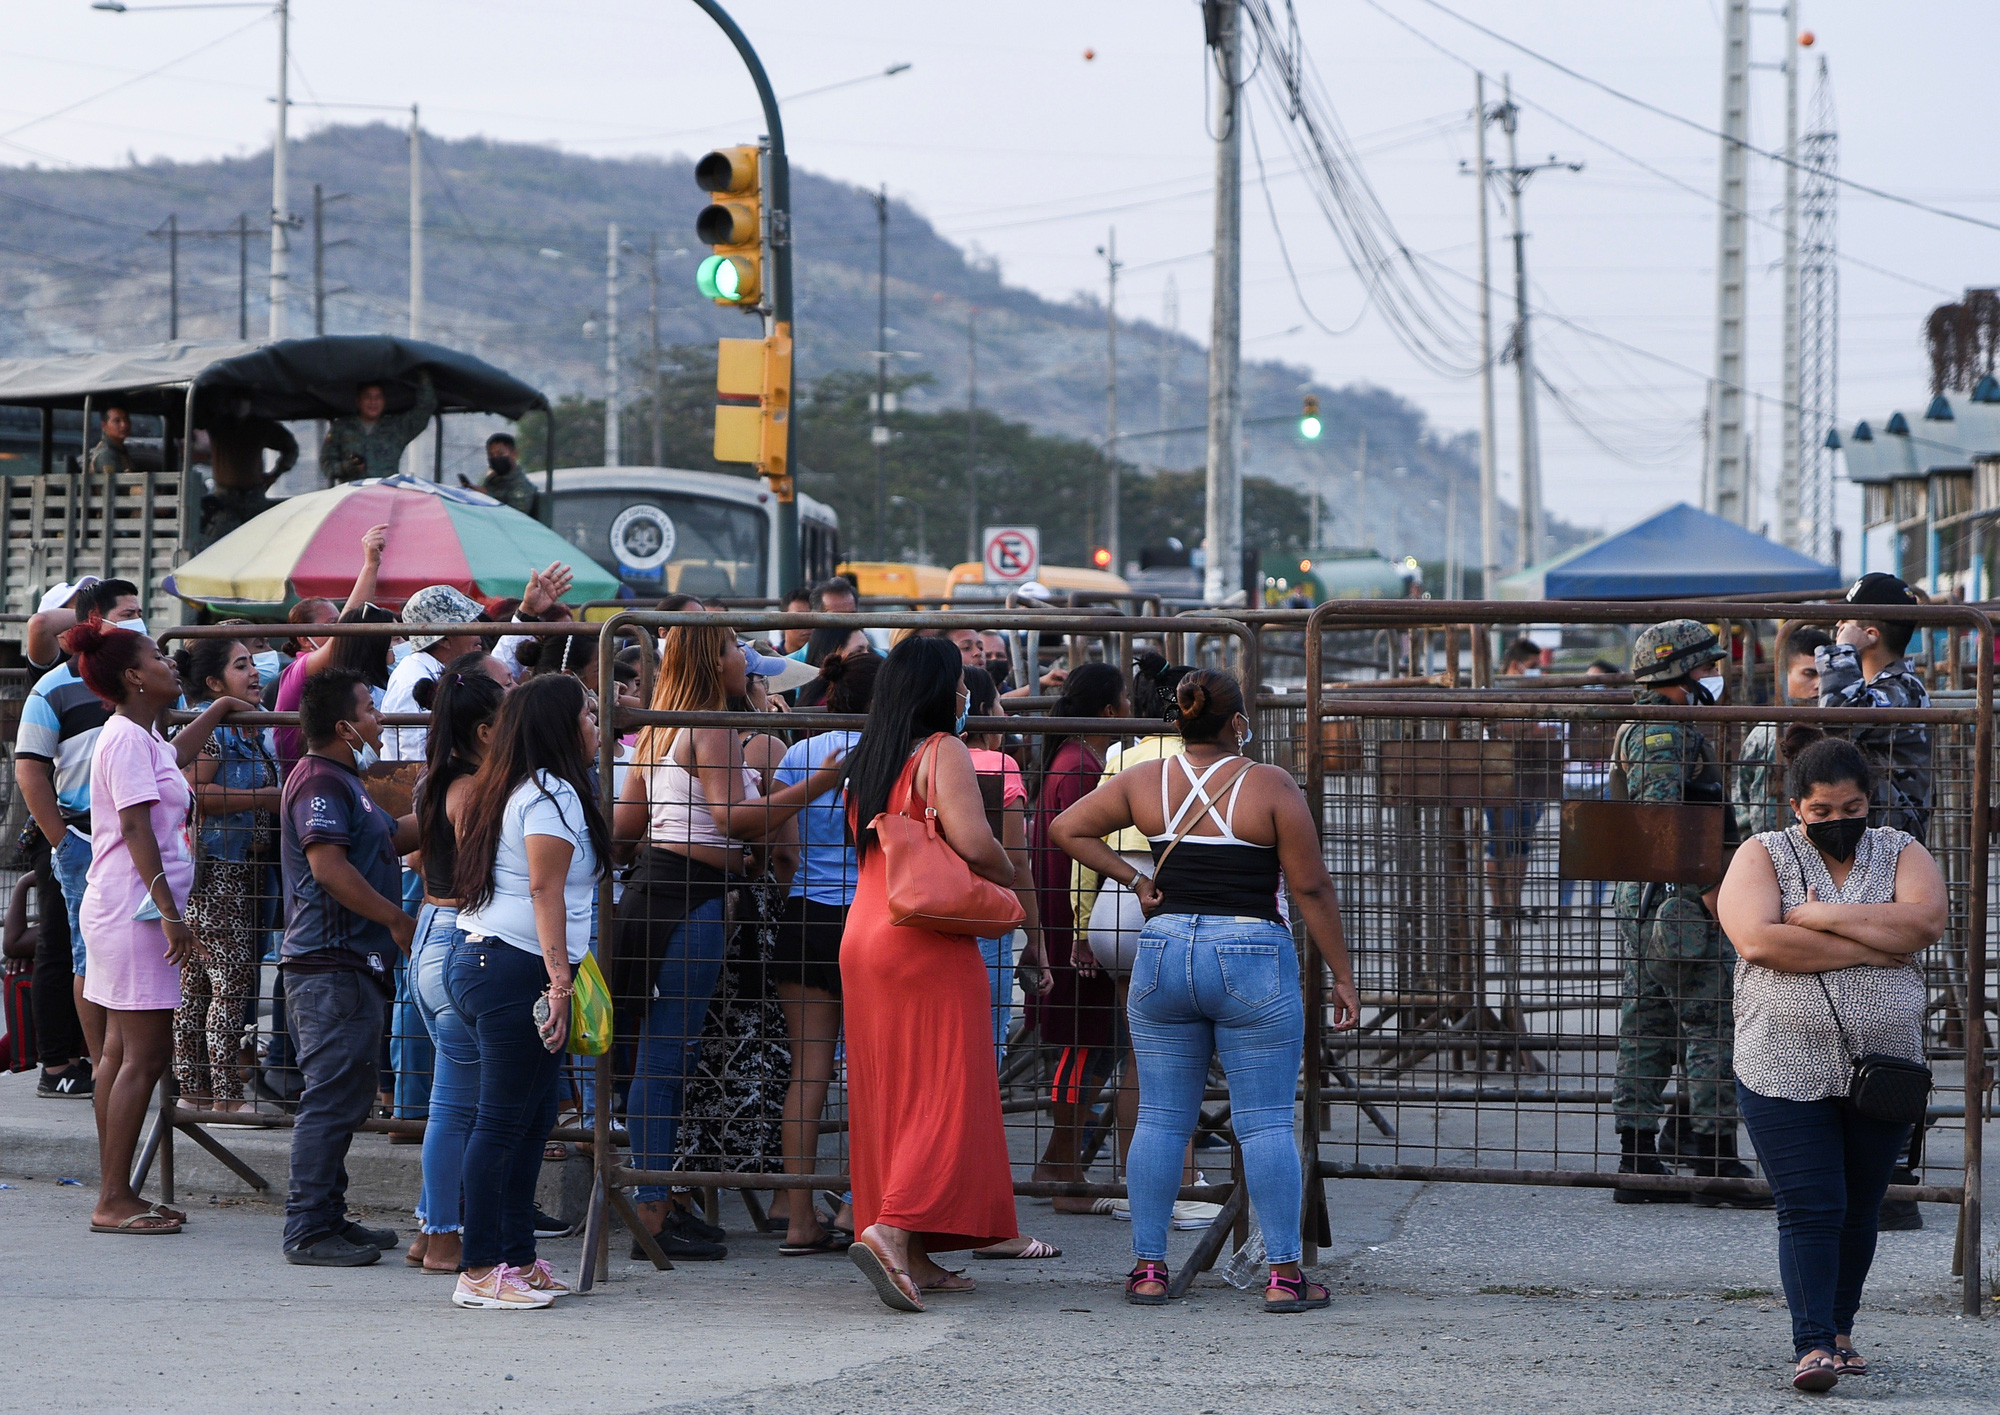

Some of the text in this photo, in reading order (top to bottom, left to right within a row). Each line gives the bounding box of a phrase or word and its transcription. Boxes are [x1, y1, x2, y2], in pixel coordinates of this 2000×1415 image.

[1001, 541, 1021, 568] E
[305, 818, 336, 826] CHAMPIONS
[56, 1077, 75, 1093] N
